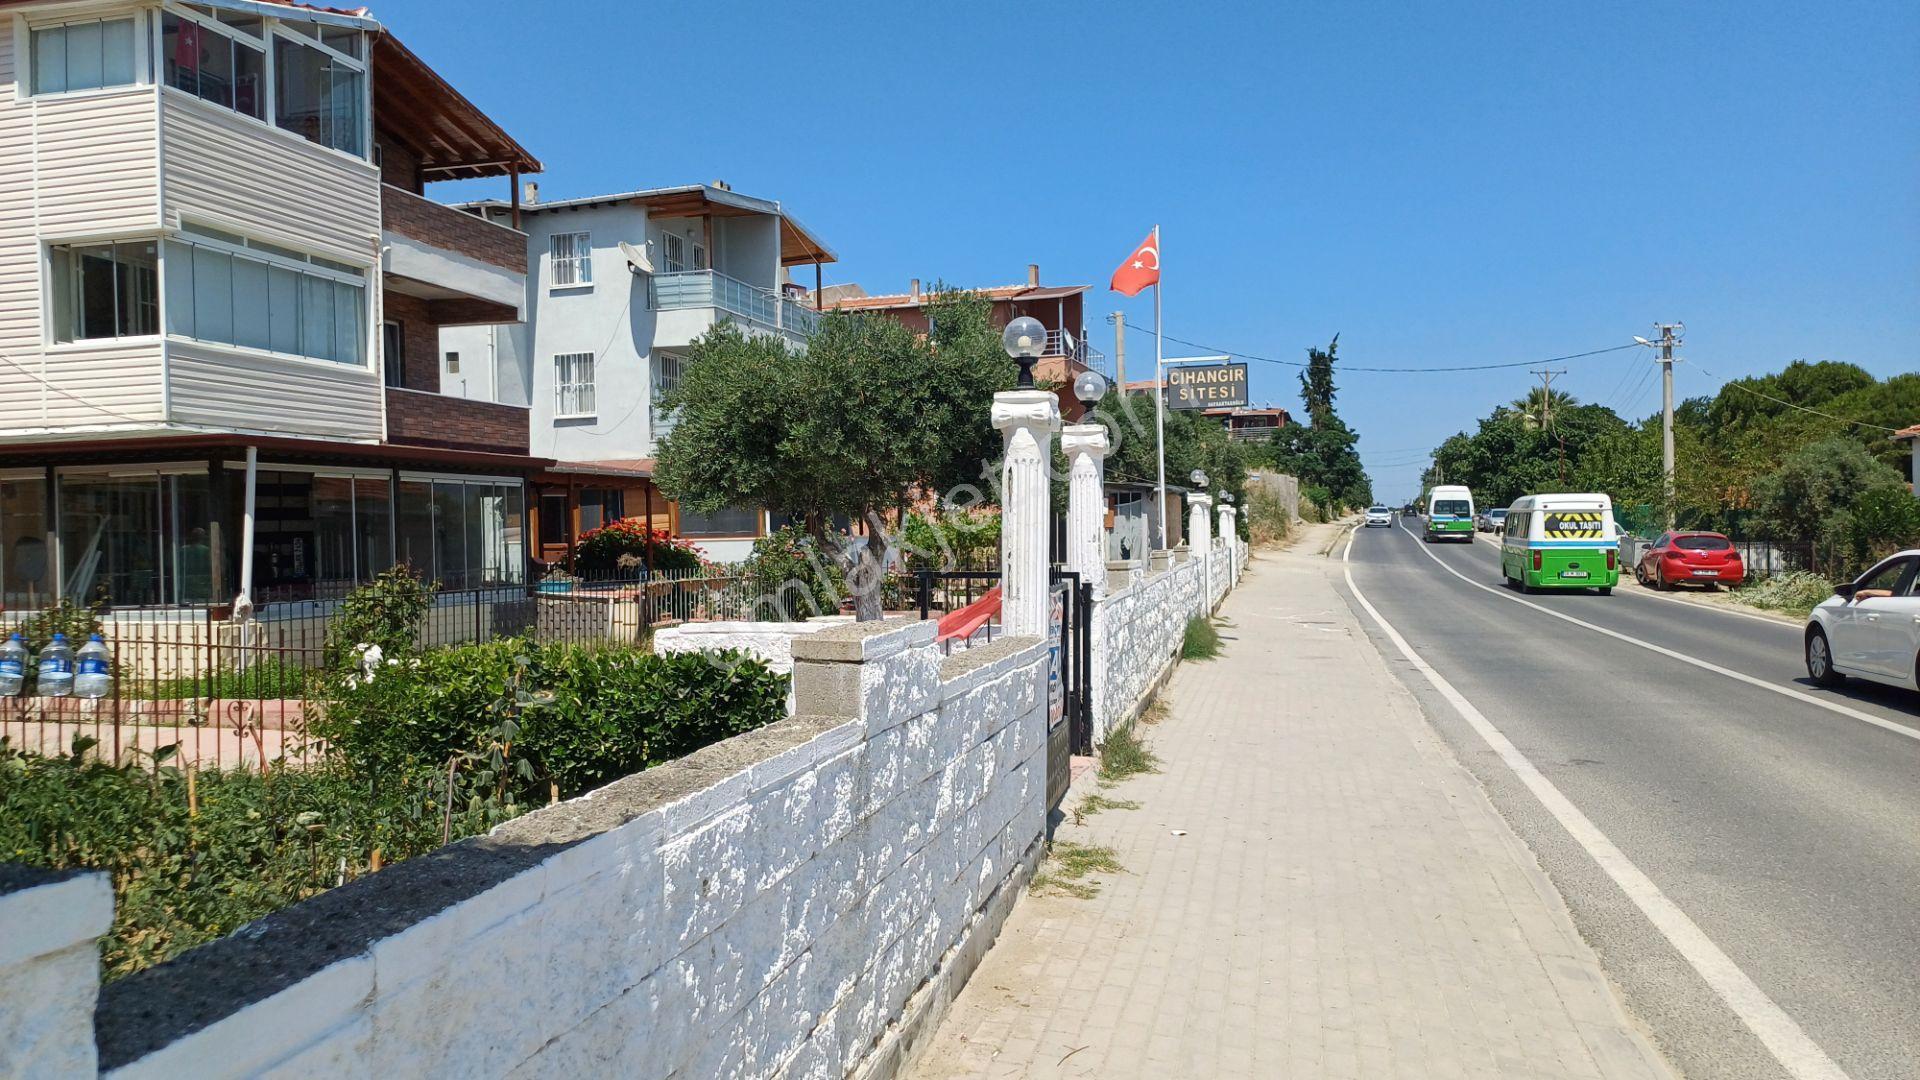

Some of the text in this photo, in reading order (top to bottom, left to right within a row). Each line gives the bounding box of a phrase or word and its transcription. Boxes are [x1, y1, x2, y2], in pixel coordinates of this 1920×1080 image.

[1170, 366, 1244, 385] CİHANGİR
[1179, 384, 1235, 400] SİTESİ
[1559, 521, 1578, 530] OKUL
